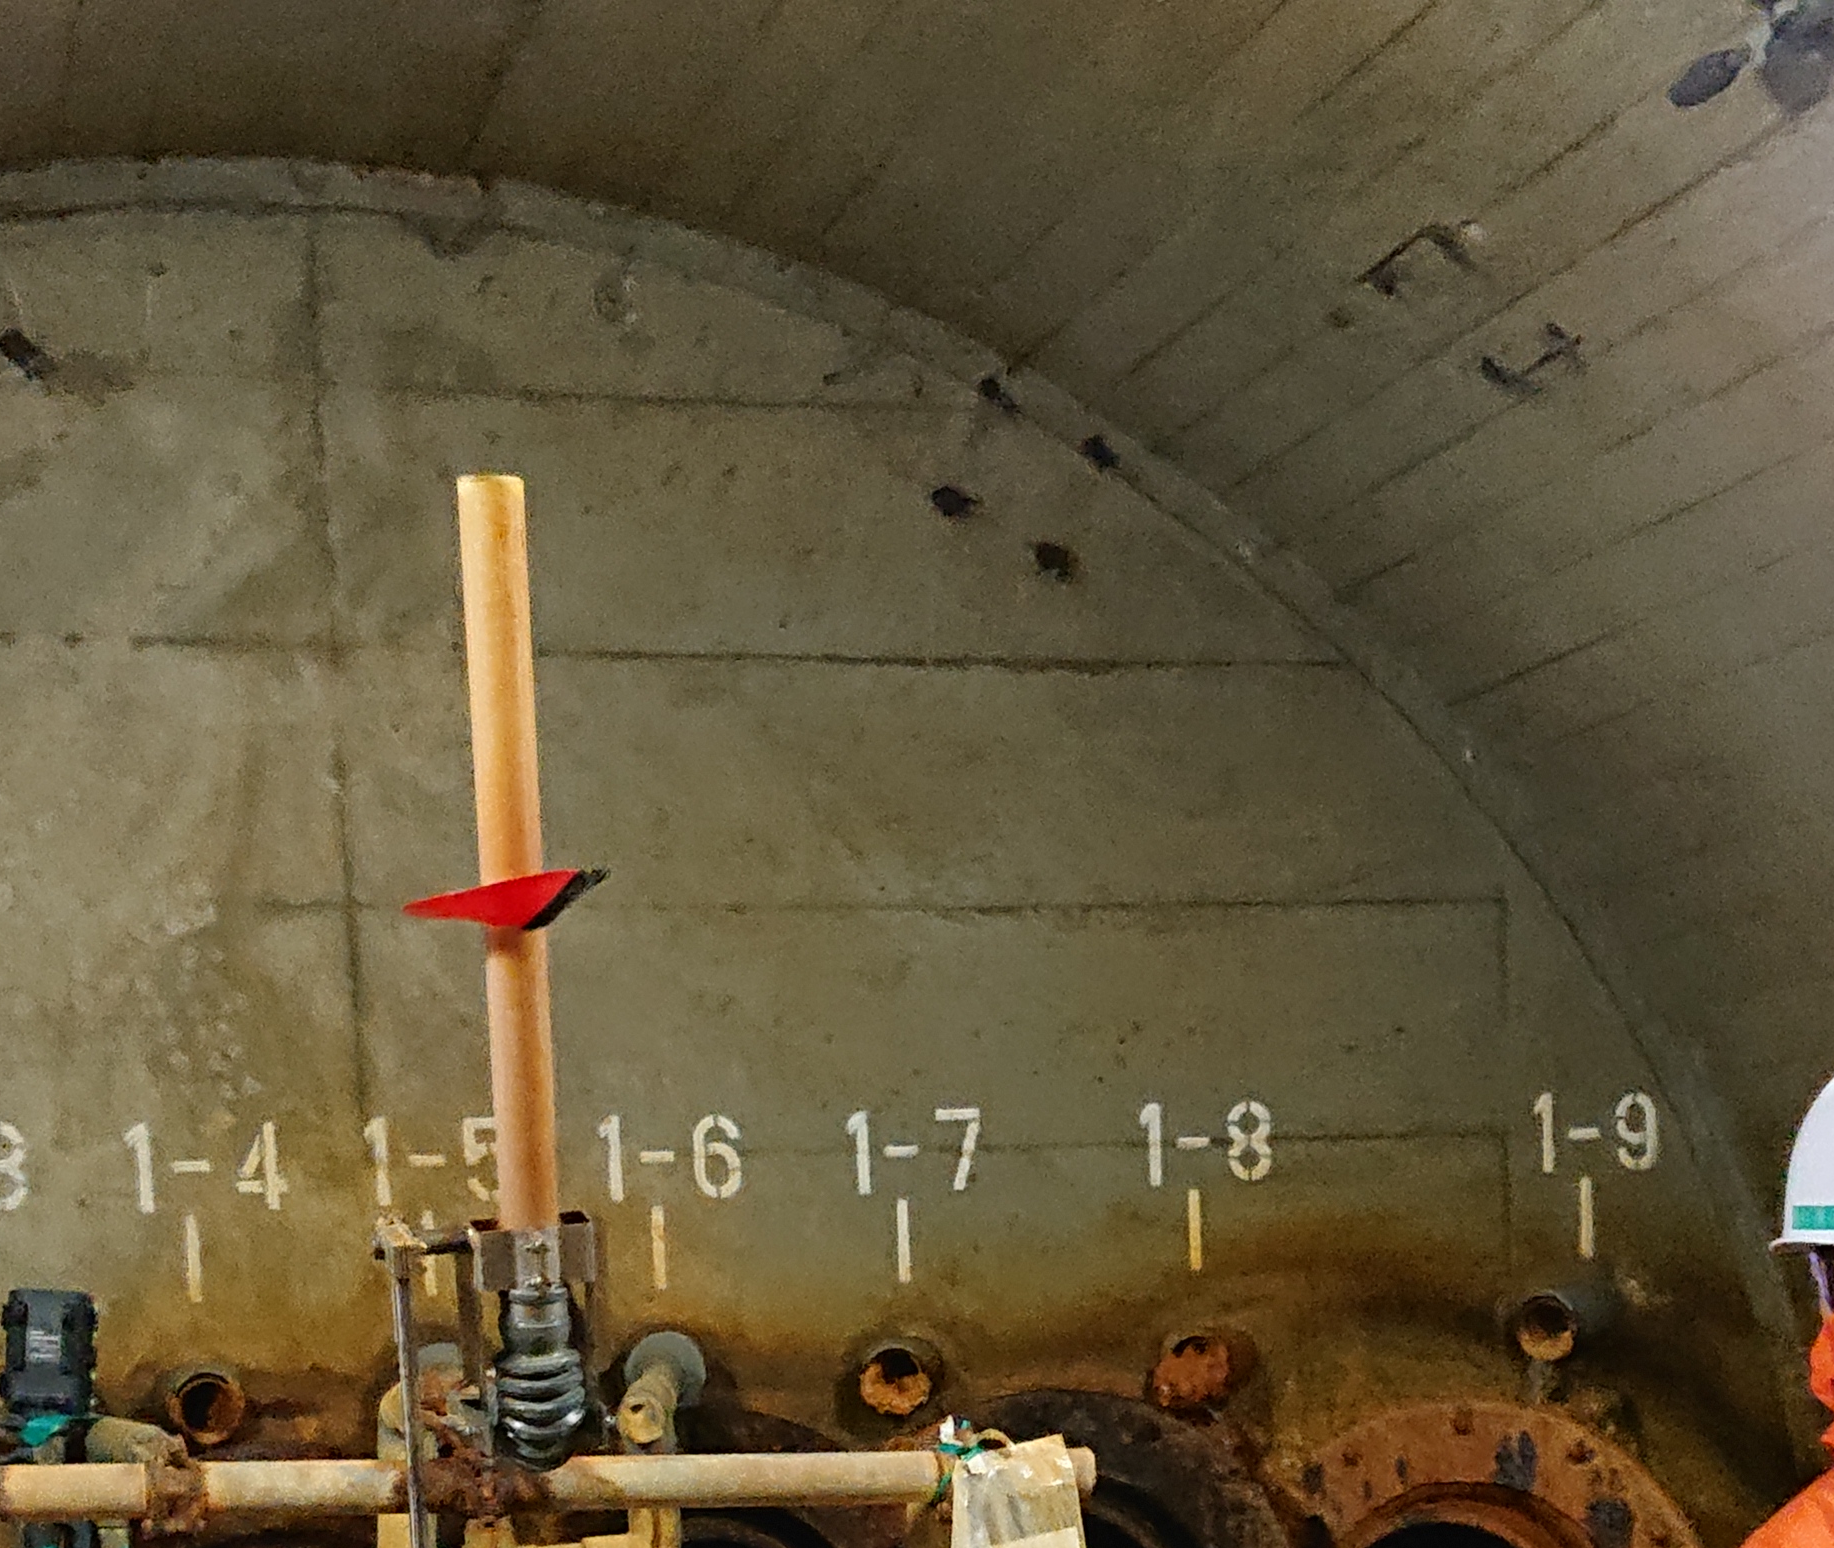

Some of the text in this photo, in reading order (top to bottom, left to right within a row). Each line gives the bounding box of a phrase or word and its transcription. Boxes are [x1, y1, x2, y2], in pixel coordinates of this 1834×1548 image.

[123, 1121, 289, 1214] 1-4
[597, 1114, 742, 1202] 1-6
[846, 1107, 980, 1195] 1-7
[1139, 1101, 1272, 1187] 1-8
[1533, 1091, 1658, 1173] 1-9
